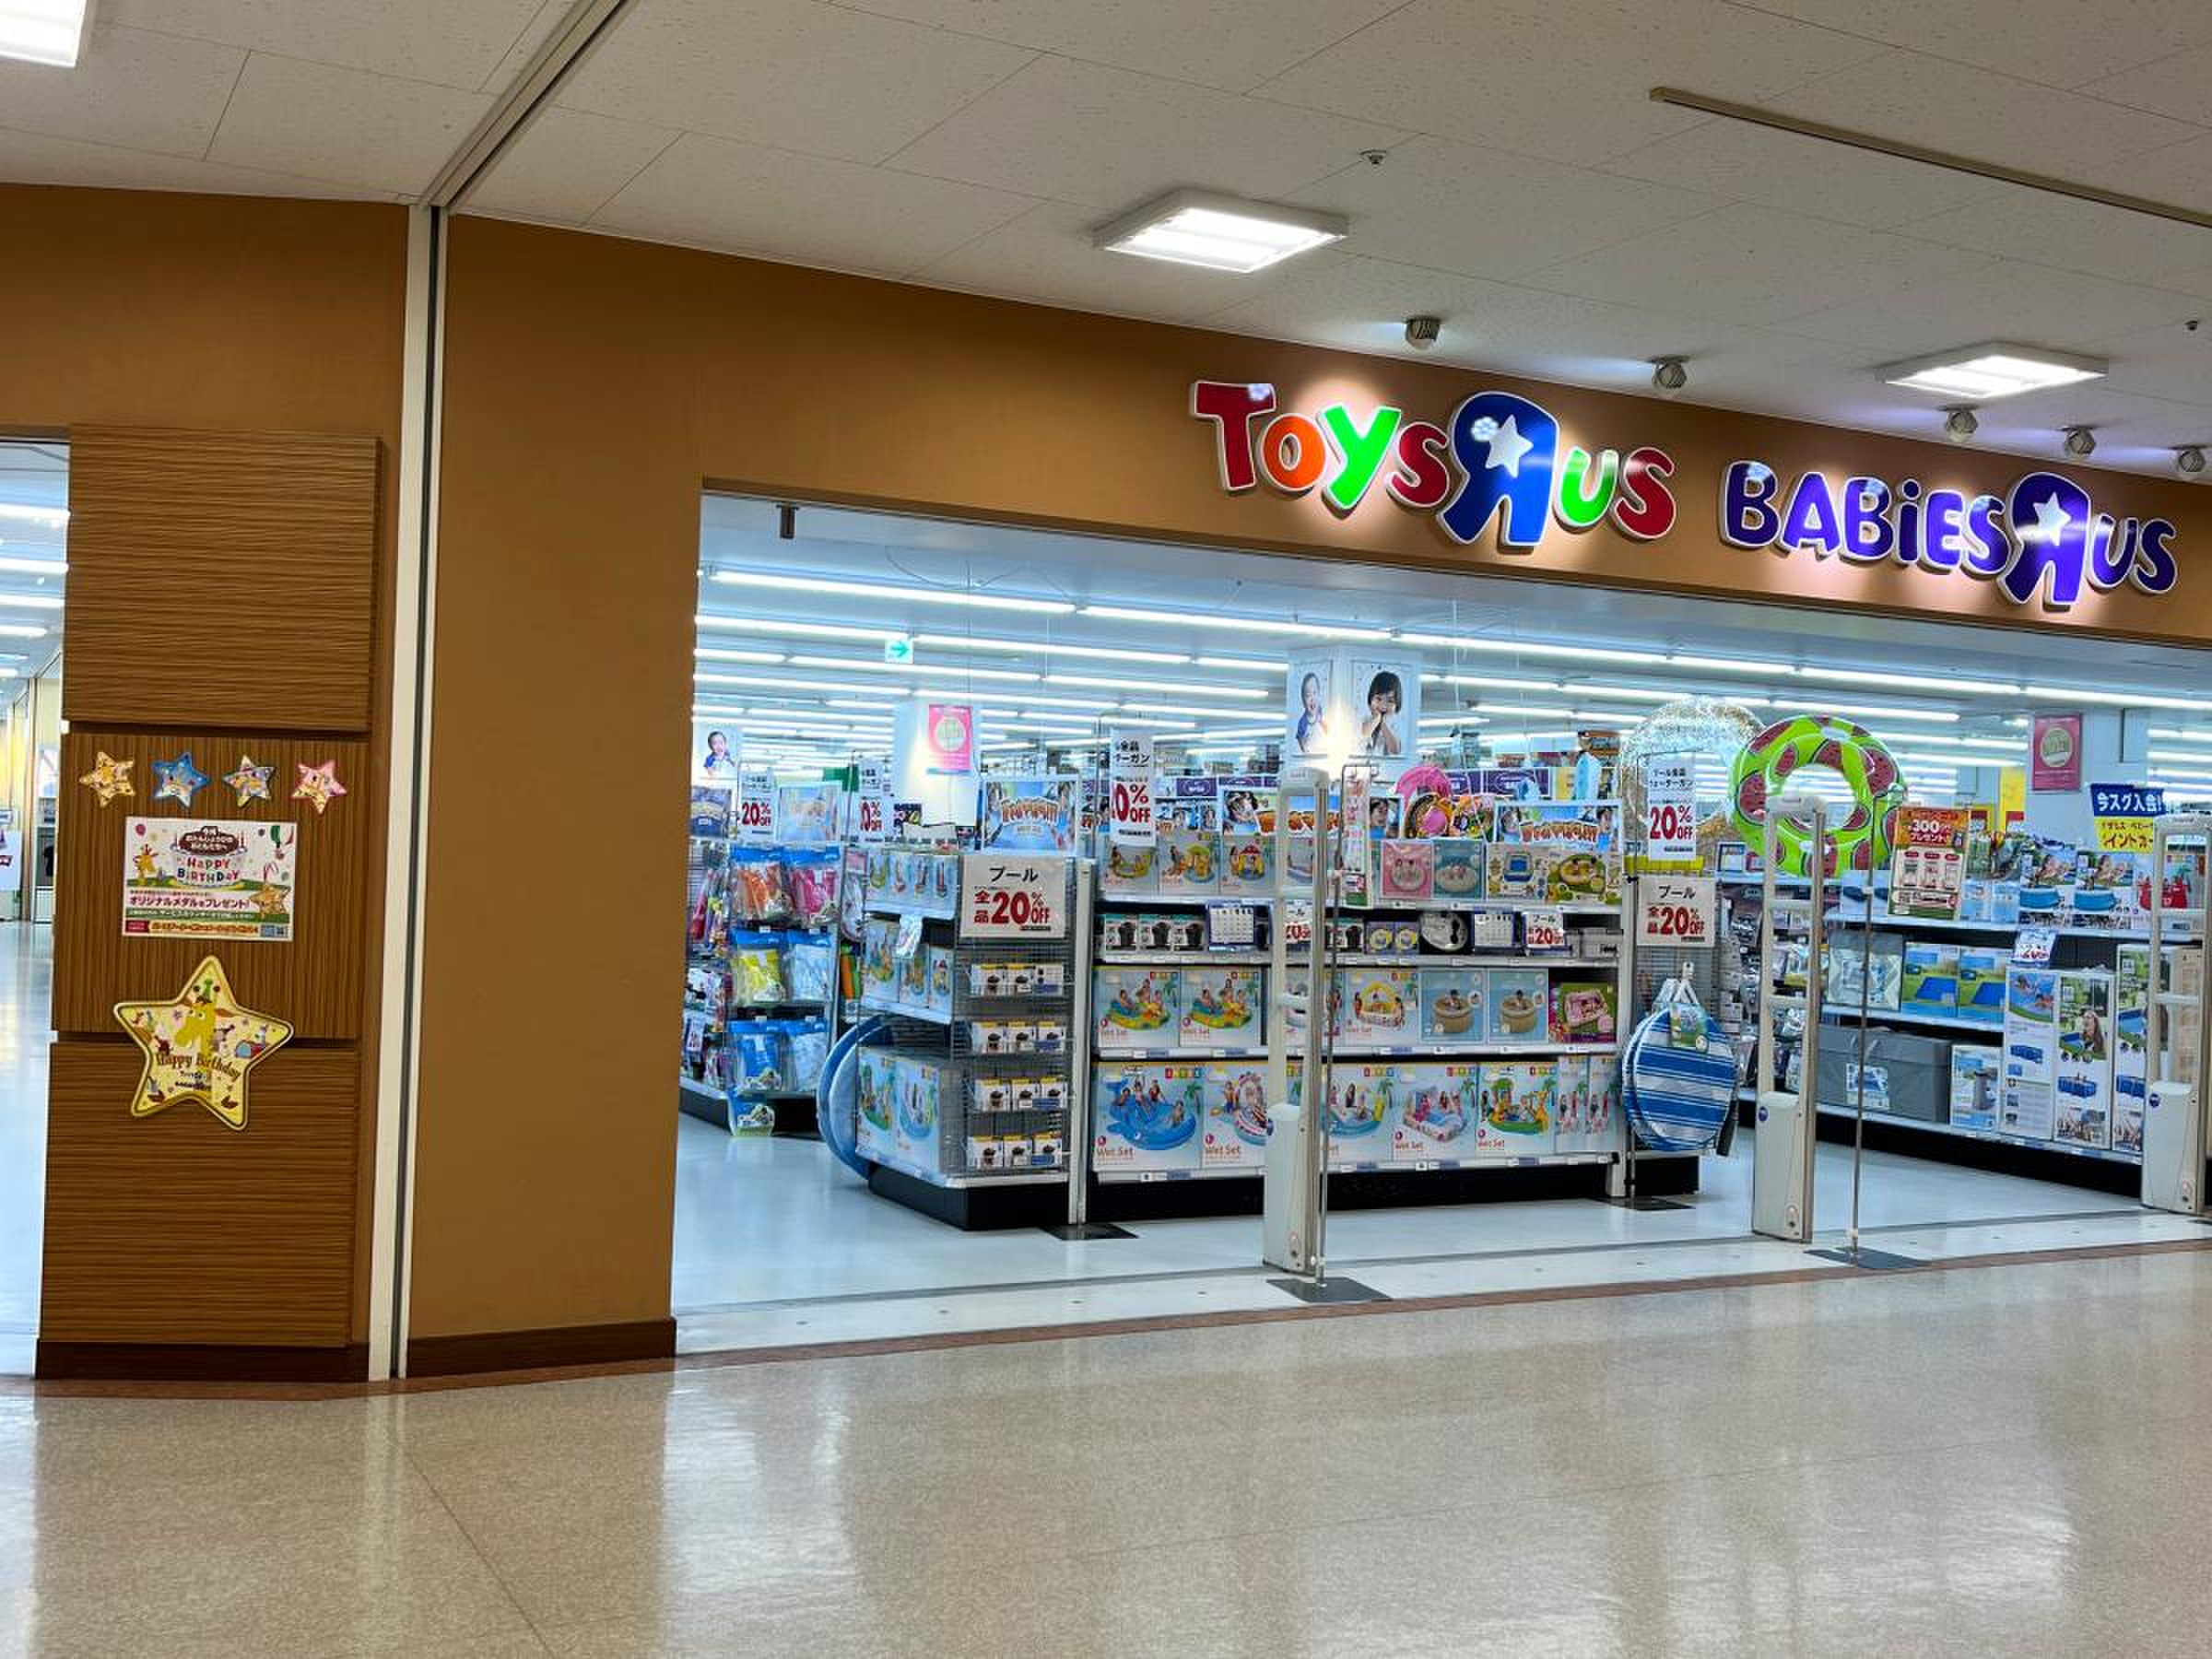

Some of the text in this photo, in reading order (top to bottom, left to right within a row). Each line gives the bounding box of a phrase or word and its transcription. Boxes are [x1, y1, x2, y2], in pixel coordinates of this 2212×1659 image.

[1677, 826, 1693, 840] OFF
[989, 865, 1039, 882] プール
[1658, 885, 1697, 900] プール
[1031, 907, 1050, 924] OFF
[155, 1051, 241, 1083] Happy Birthday
